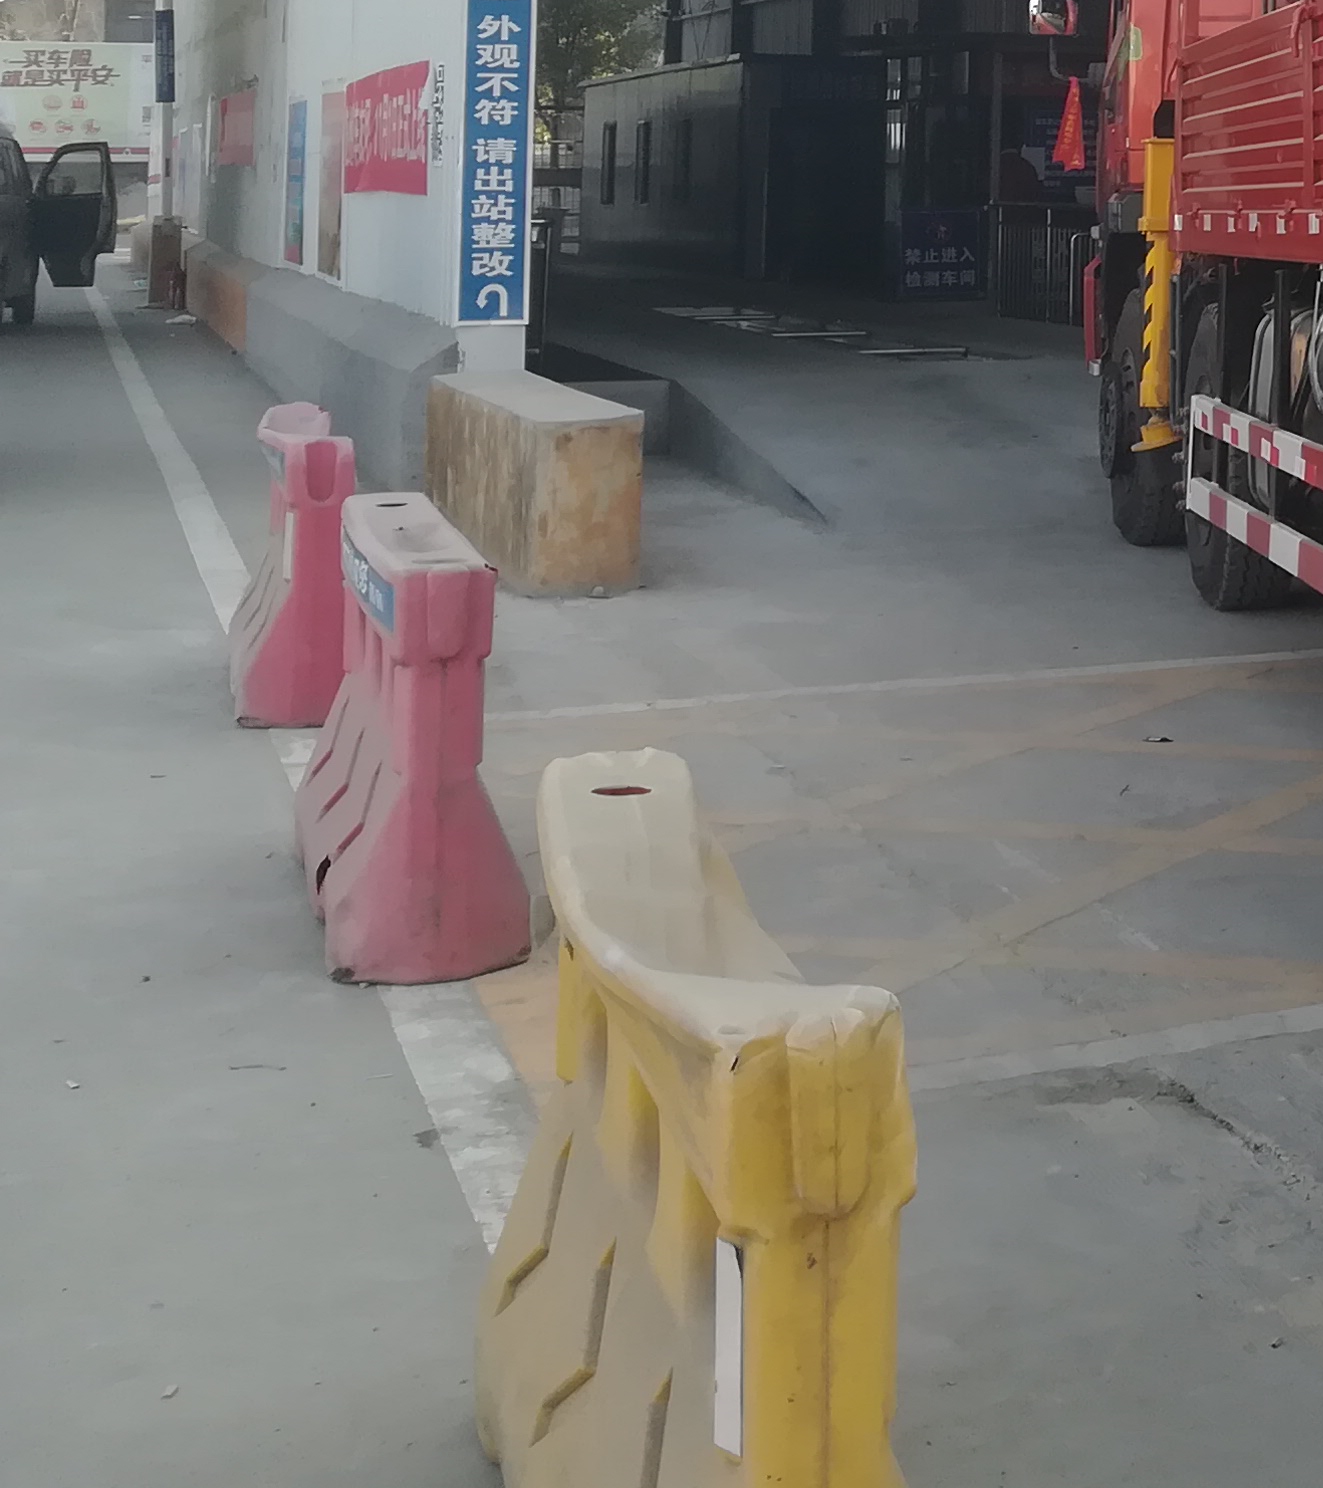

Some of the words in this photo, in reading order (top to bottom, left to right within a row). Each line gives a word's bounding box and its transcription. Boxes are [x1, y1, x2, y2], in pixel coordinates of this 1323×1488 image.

[473, 14, 522, 126] 外观不符
[471, 138, 517, 277] 请出站整改
[904, 246, 976, 265] 禁止进入
[904, 269, 976, 288] 检测车间
